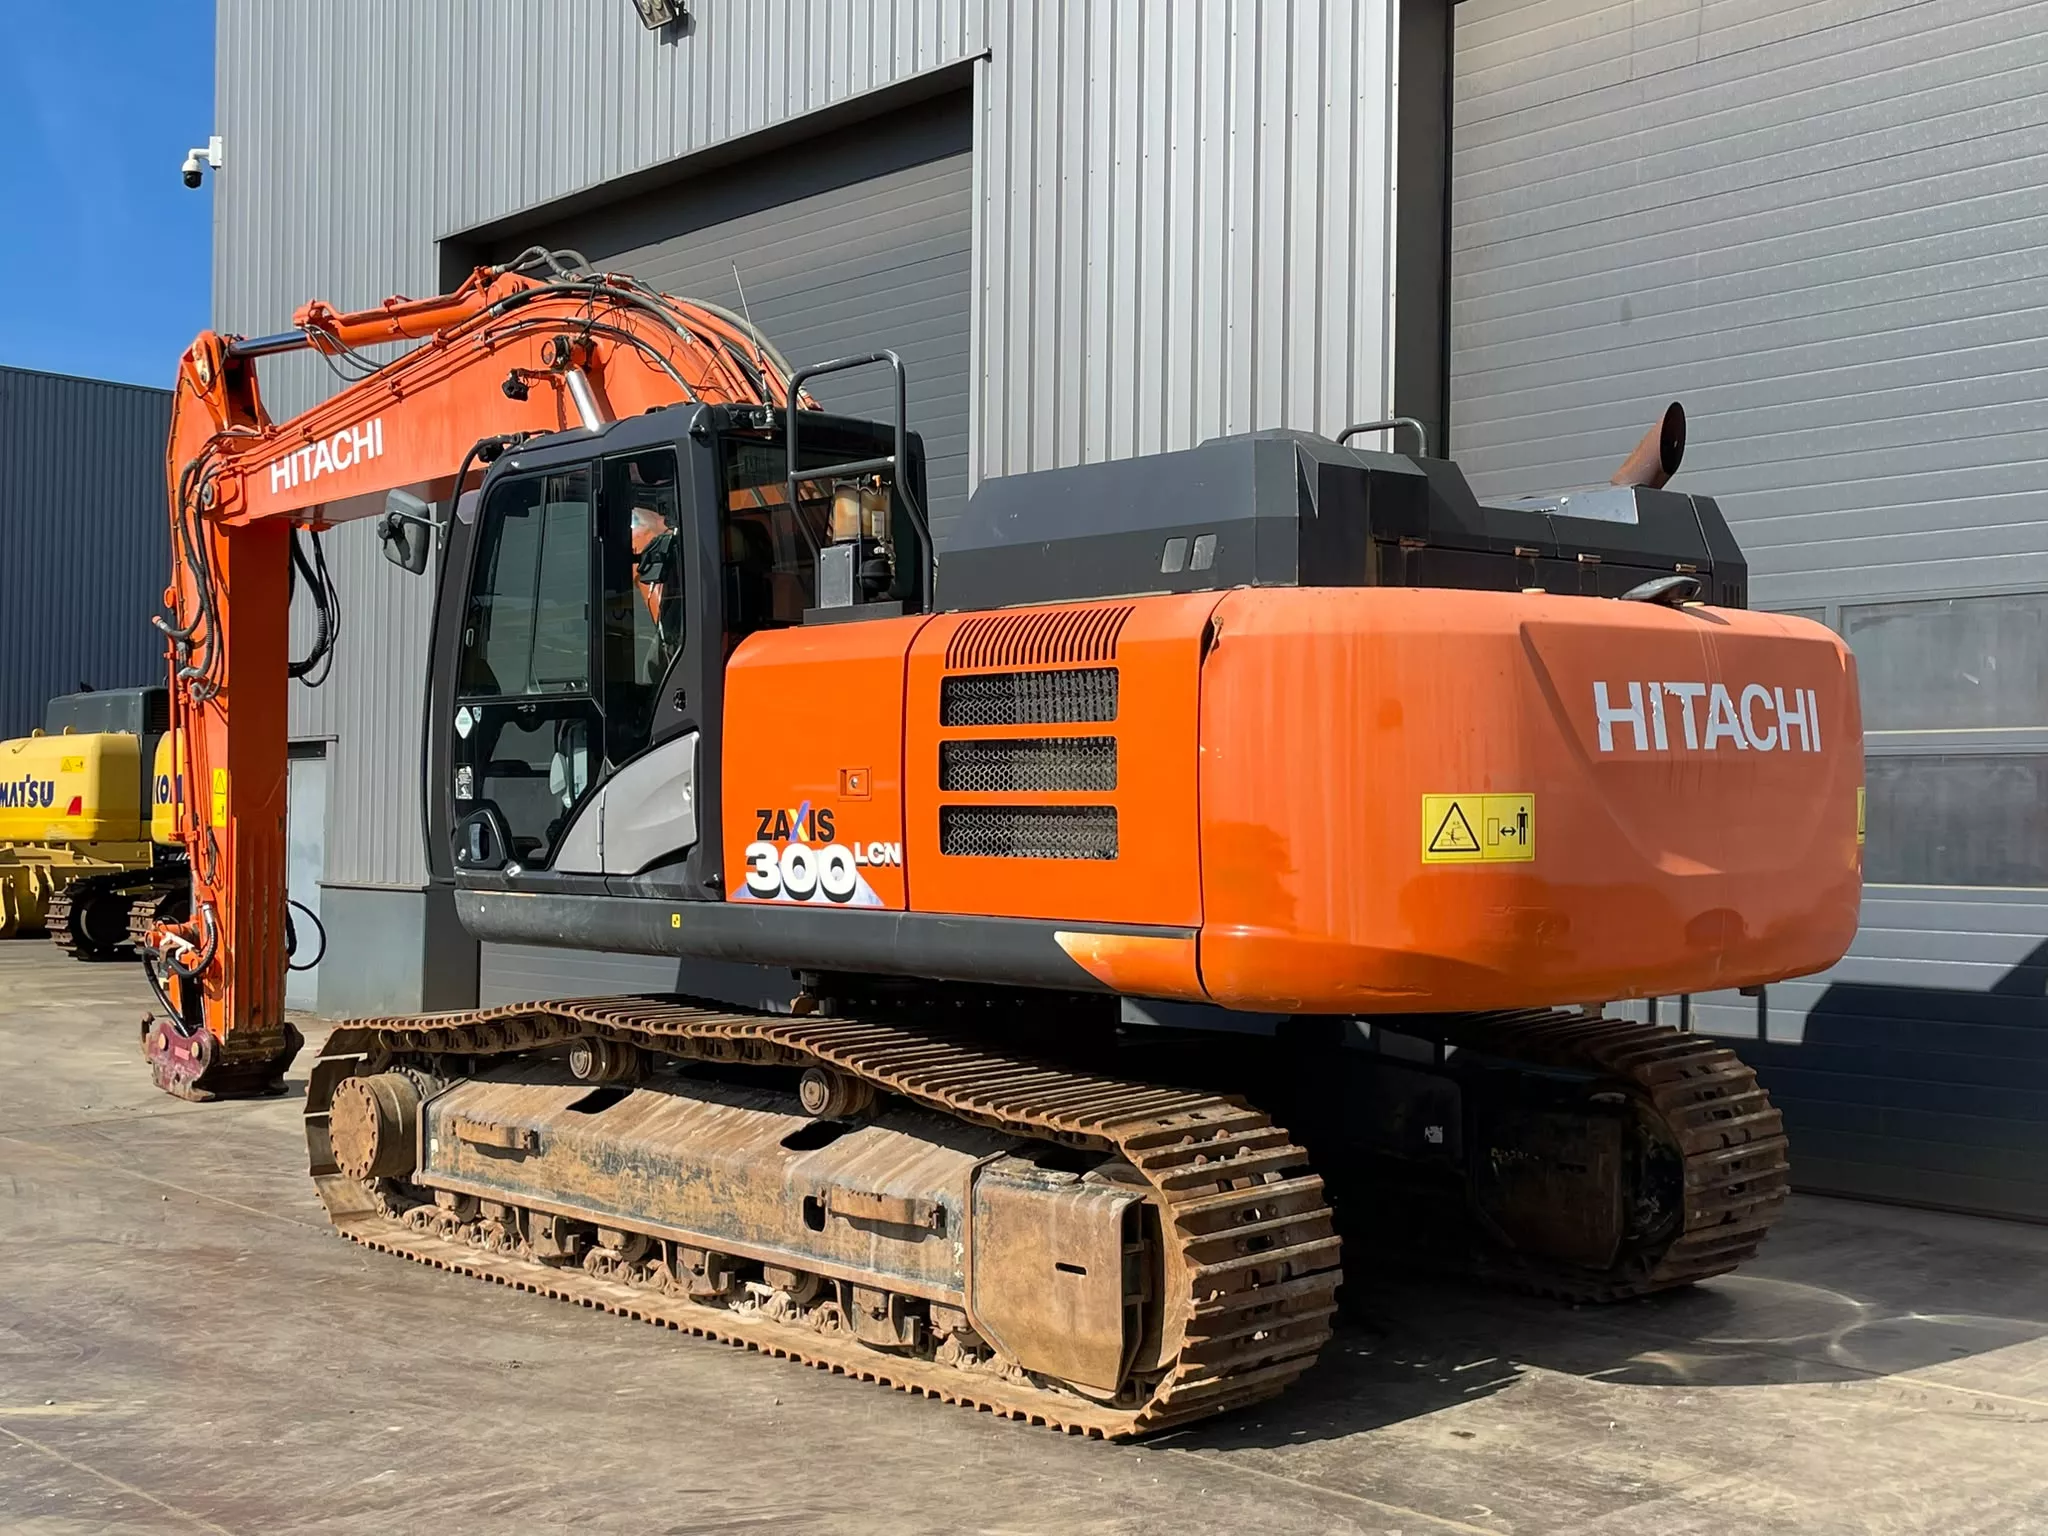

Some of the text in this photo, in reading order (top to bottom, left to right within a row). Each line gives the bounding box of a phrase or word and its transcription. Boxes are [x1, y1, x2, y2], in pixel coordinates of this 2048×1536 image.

[271, 418, 383, 494] HITACHI
[1593, 681, 1821, 752] HITACHI
[756, 800, 835, 842] ZAXIS
[745, 841, 901, 903] 300 LCN
